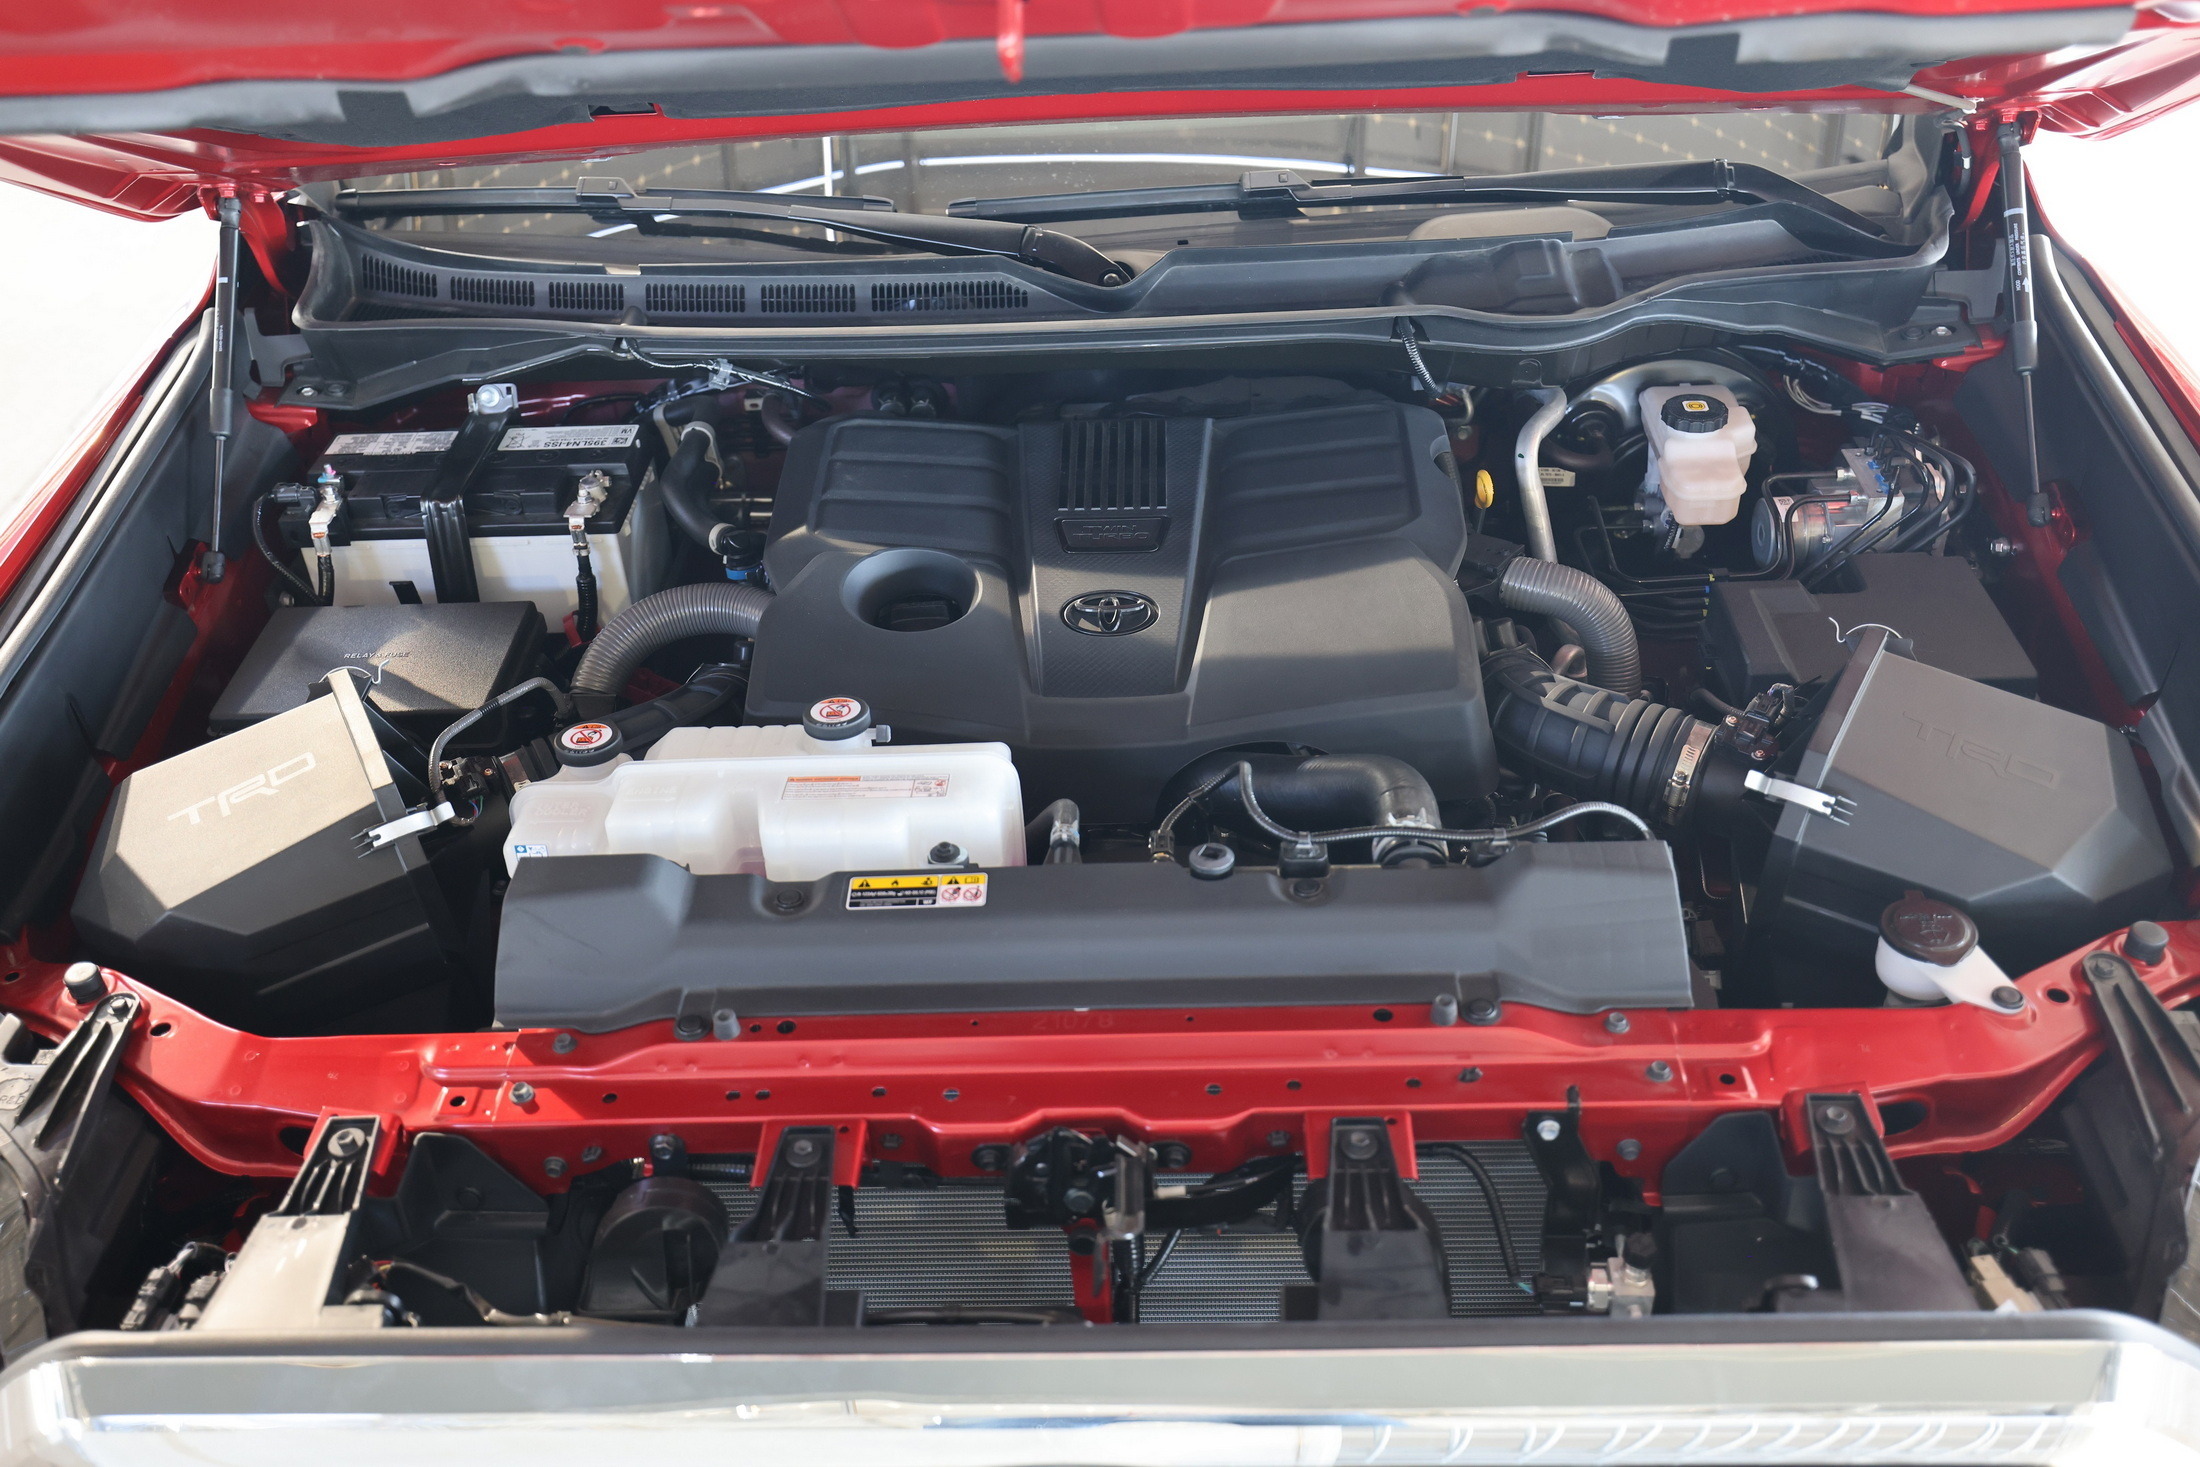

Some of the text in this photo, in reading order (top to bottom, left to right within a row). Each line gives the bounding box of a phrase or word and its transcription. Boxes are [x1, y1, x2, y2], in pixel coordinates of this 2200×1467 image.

[543, 439, 608, 448] 395LN4-ISS
[1082, 525, 1137, 533] TWIN
[1073, 531, 1150, 540] TURBO
[1902, 710, 2060, 789] TRD
[166, 751, 317, 825] TRD
